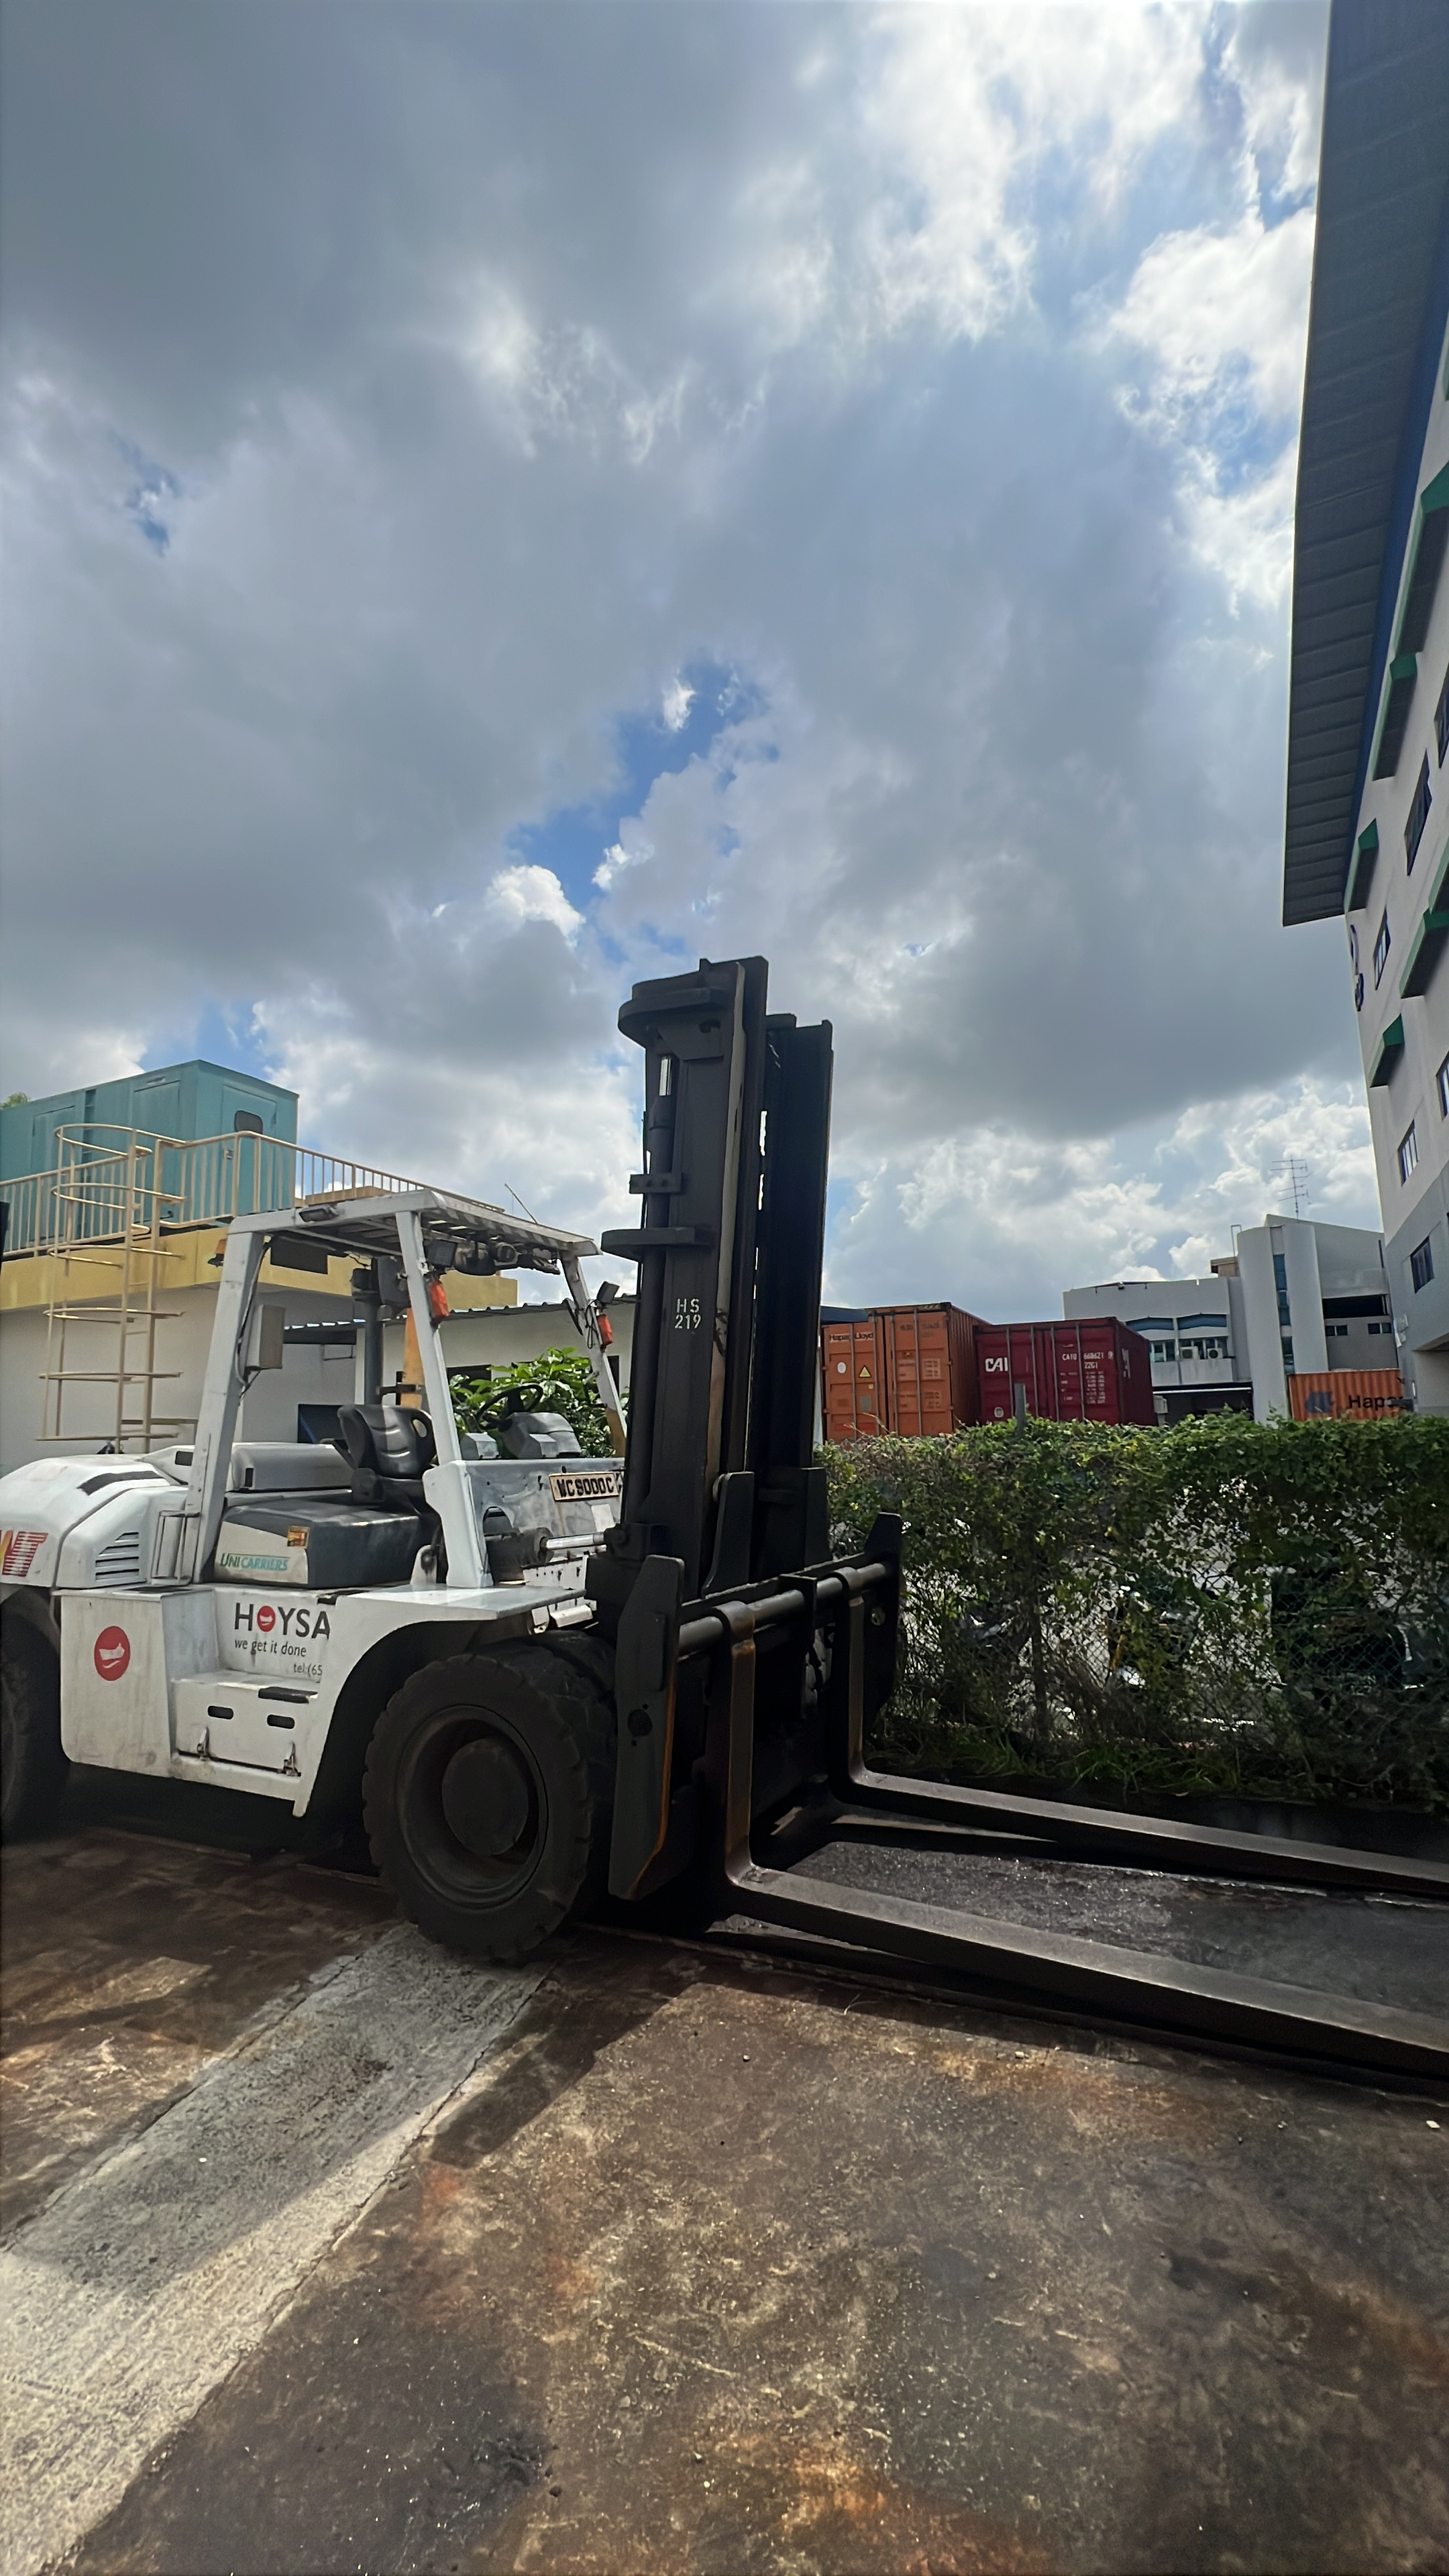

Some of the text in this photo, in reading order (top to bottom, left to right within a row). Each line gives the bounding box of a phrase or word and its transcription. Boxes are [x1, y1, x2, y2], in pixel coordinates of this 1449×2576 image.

[677, 1298, 699, 1313] HS
[675, 1314, 701, 1329] 219
[985, 1357, 1008, 1372] CAI
[235, 1639, 307, 1657] we get it done
